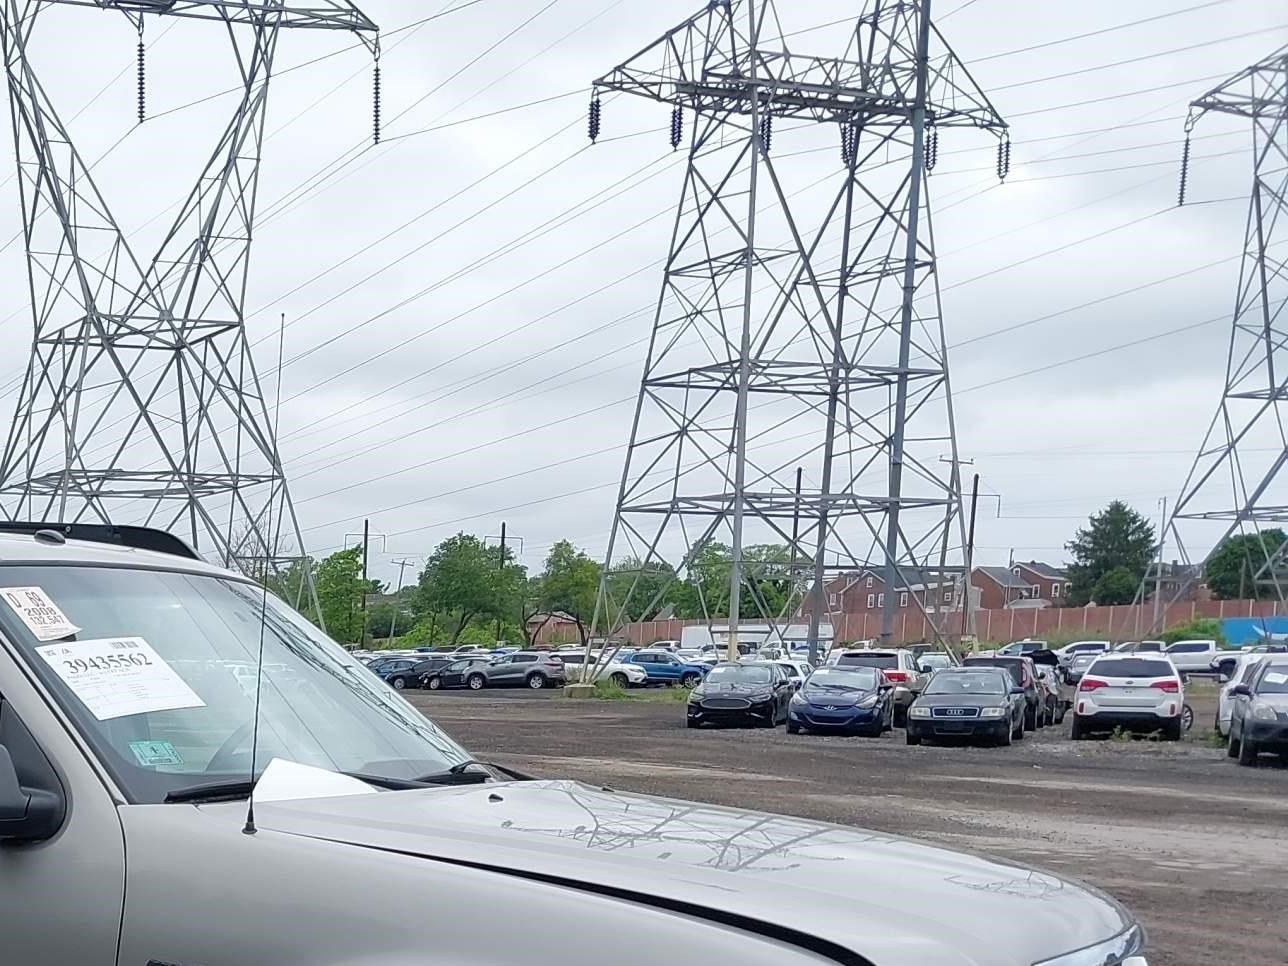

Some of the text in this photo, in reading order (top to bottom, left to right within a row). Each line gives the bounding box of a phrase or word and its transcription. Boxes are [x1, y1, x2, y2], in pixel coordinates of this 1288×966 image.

[25, 591, 46, 607] 69
[24, 606, 57, 617] 2008
[63, 652, 153, 675] 39435562
